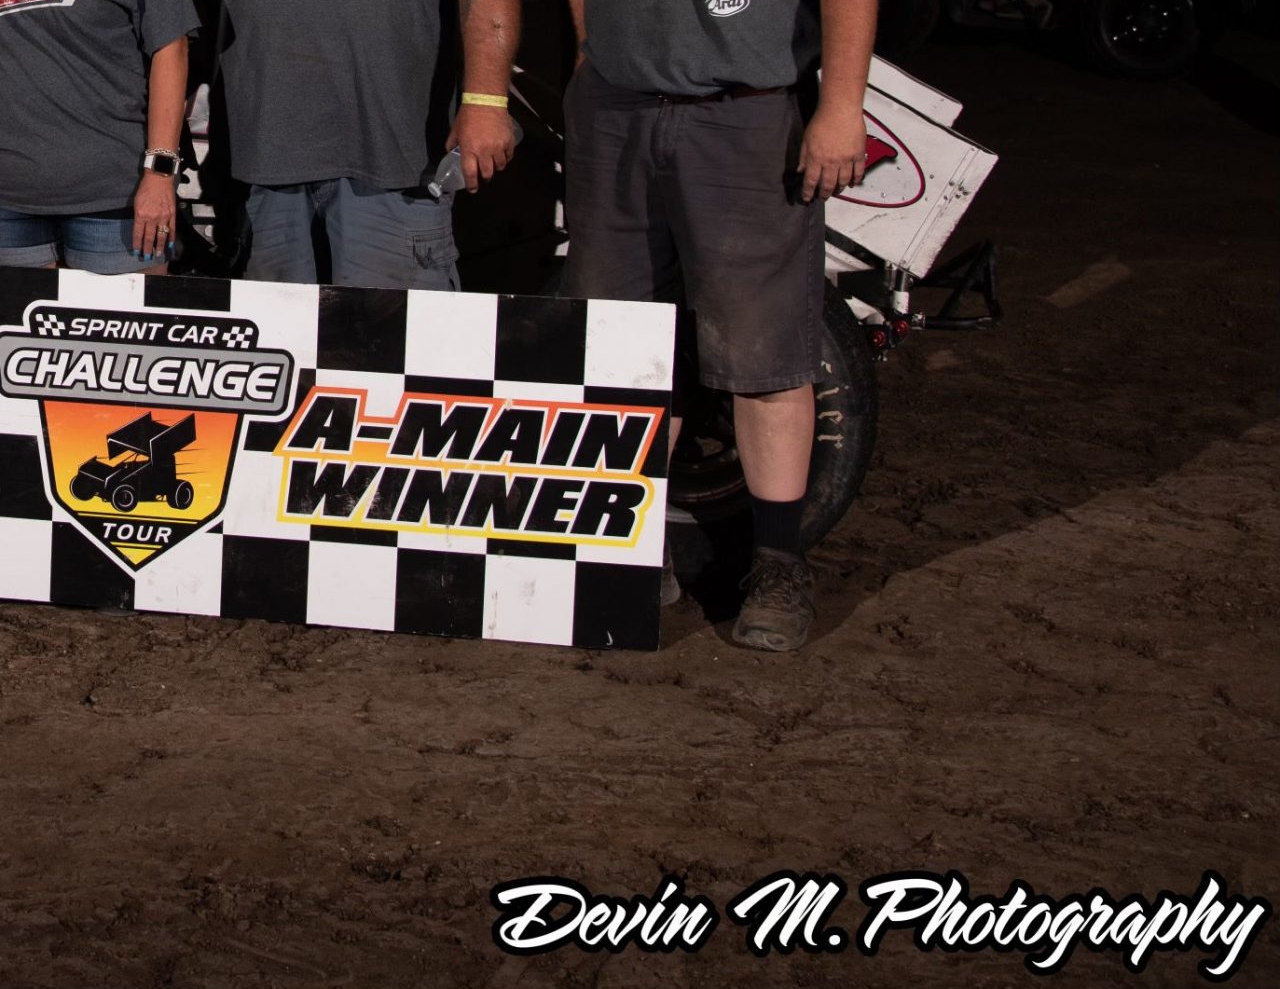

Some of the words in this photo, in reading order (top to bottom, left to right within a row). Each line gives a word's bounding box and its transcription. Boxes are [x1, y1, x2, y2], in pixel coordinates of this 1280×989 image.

[68, 317, 164, 343] SPRINT
[168, 324, 219, 346] CAR
[4, 347, 280, 402] CHALLENGE
[287, 396, 649, 473] A-MAIN
[285, 460, 648, 538] WINNER
[102, 523, 171, 544] TOUR
